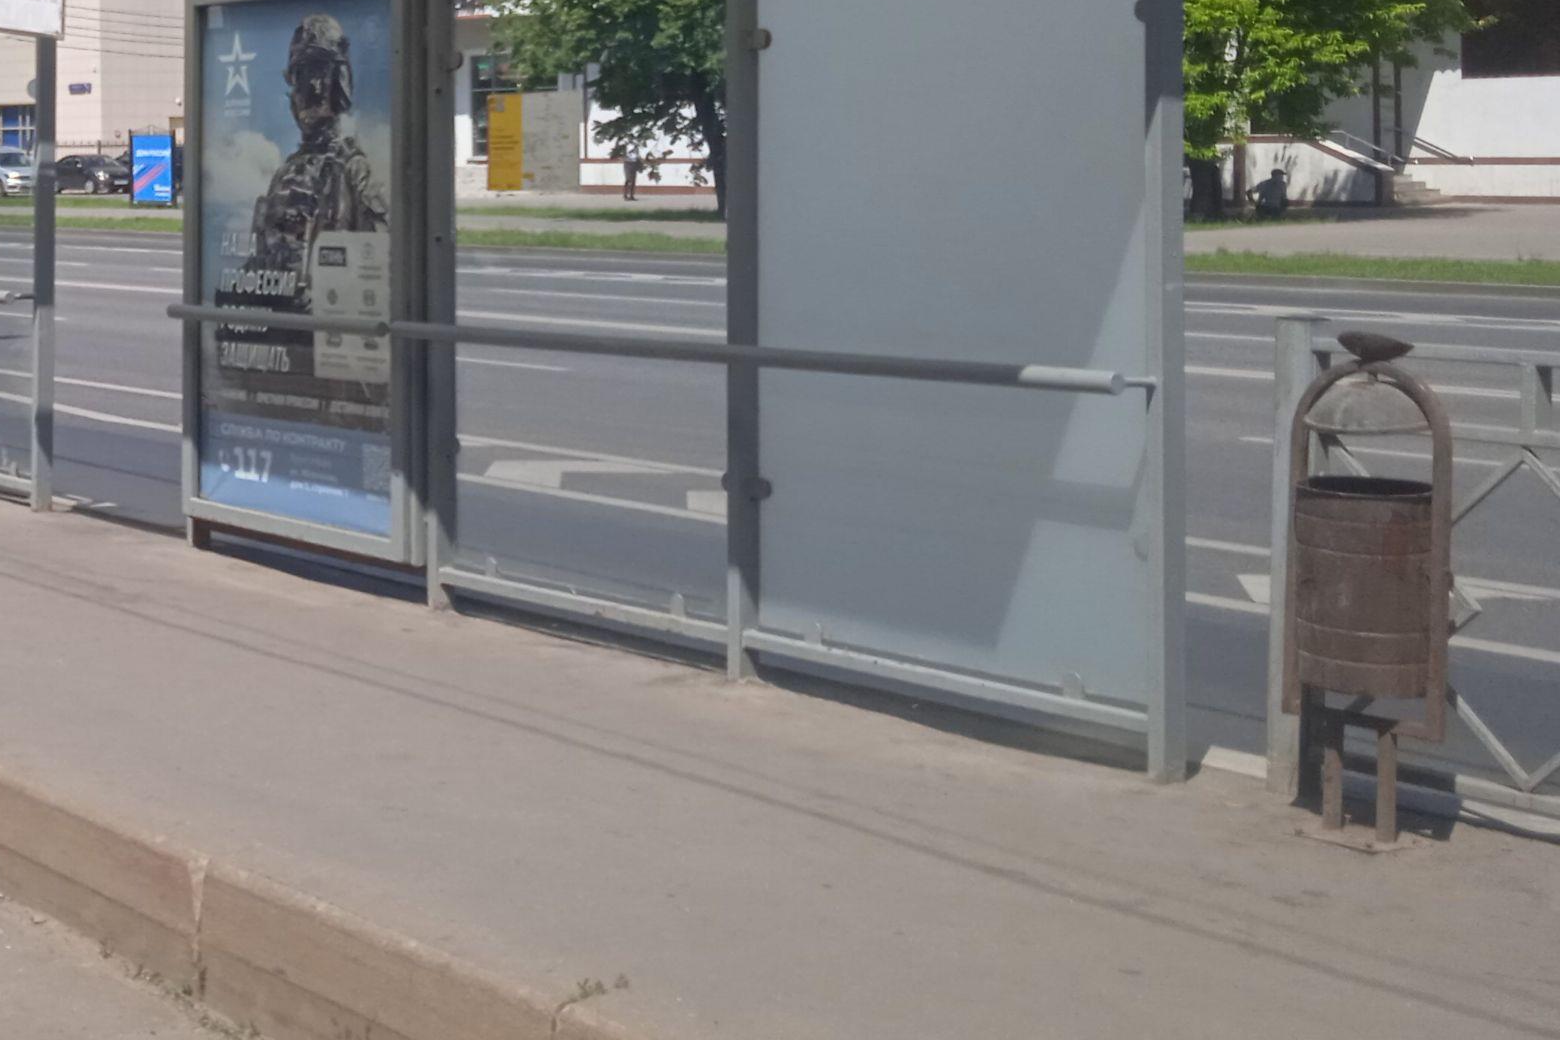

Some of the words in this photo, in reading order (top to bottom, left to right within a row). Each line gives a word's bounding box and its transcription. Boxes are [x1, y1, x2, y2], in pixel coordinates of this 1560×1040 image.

[221, 232, 257, 257] НАША
[221, 268, 296, 297] ПРОФЕССИЯ
[220, 341, 290, 373] ЗАЩИЩАТЬ
[234, 446, 272, 483] 117
